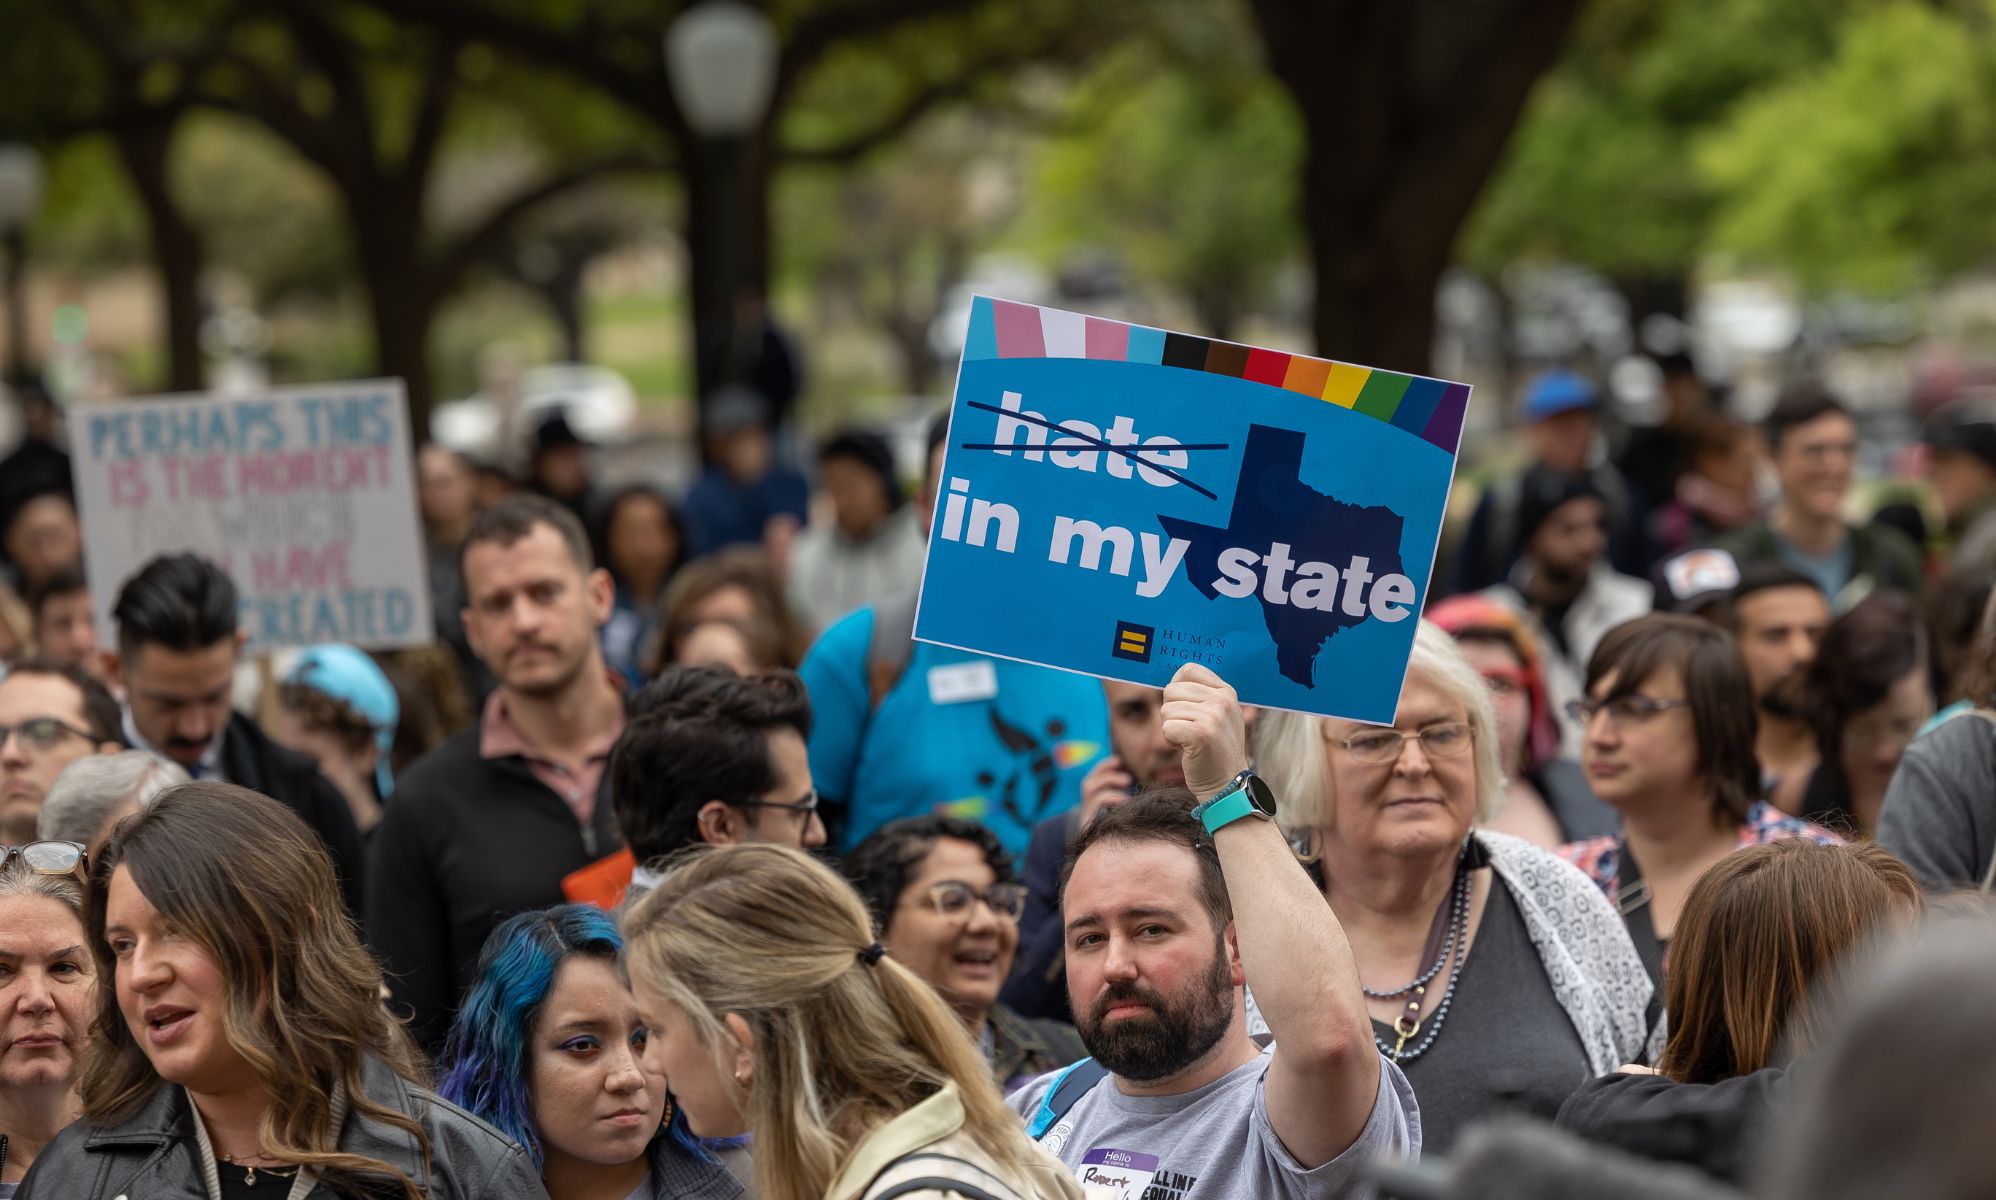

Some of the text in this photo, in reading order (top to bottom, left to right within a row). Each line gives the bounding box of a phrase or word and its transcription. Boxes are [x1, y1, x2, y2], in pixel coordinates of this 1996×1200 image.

[90, 395, 393, 458] PERHAPS THIS
[993, 391, 1189, 488] hate
[108, 445, 391, 509] IS THE MOMENT
[251, 541, 352, 591] HAVE
[940, 476, 1416, 624] in my state
[1160, 645, 1224, 665] RIGHTS
[1163, 629, 1227, 649] HUMAN
[1104, 1151, 1132, 1163] Hello
